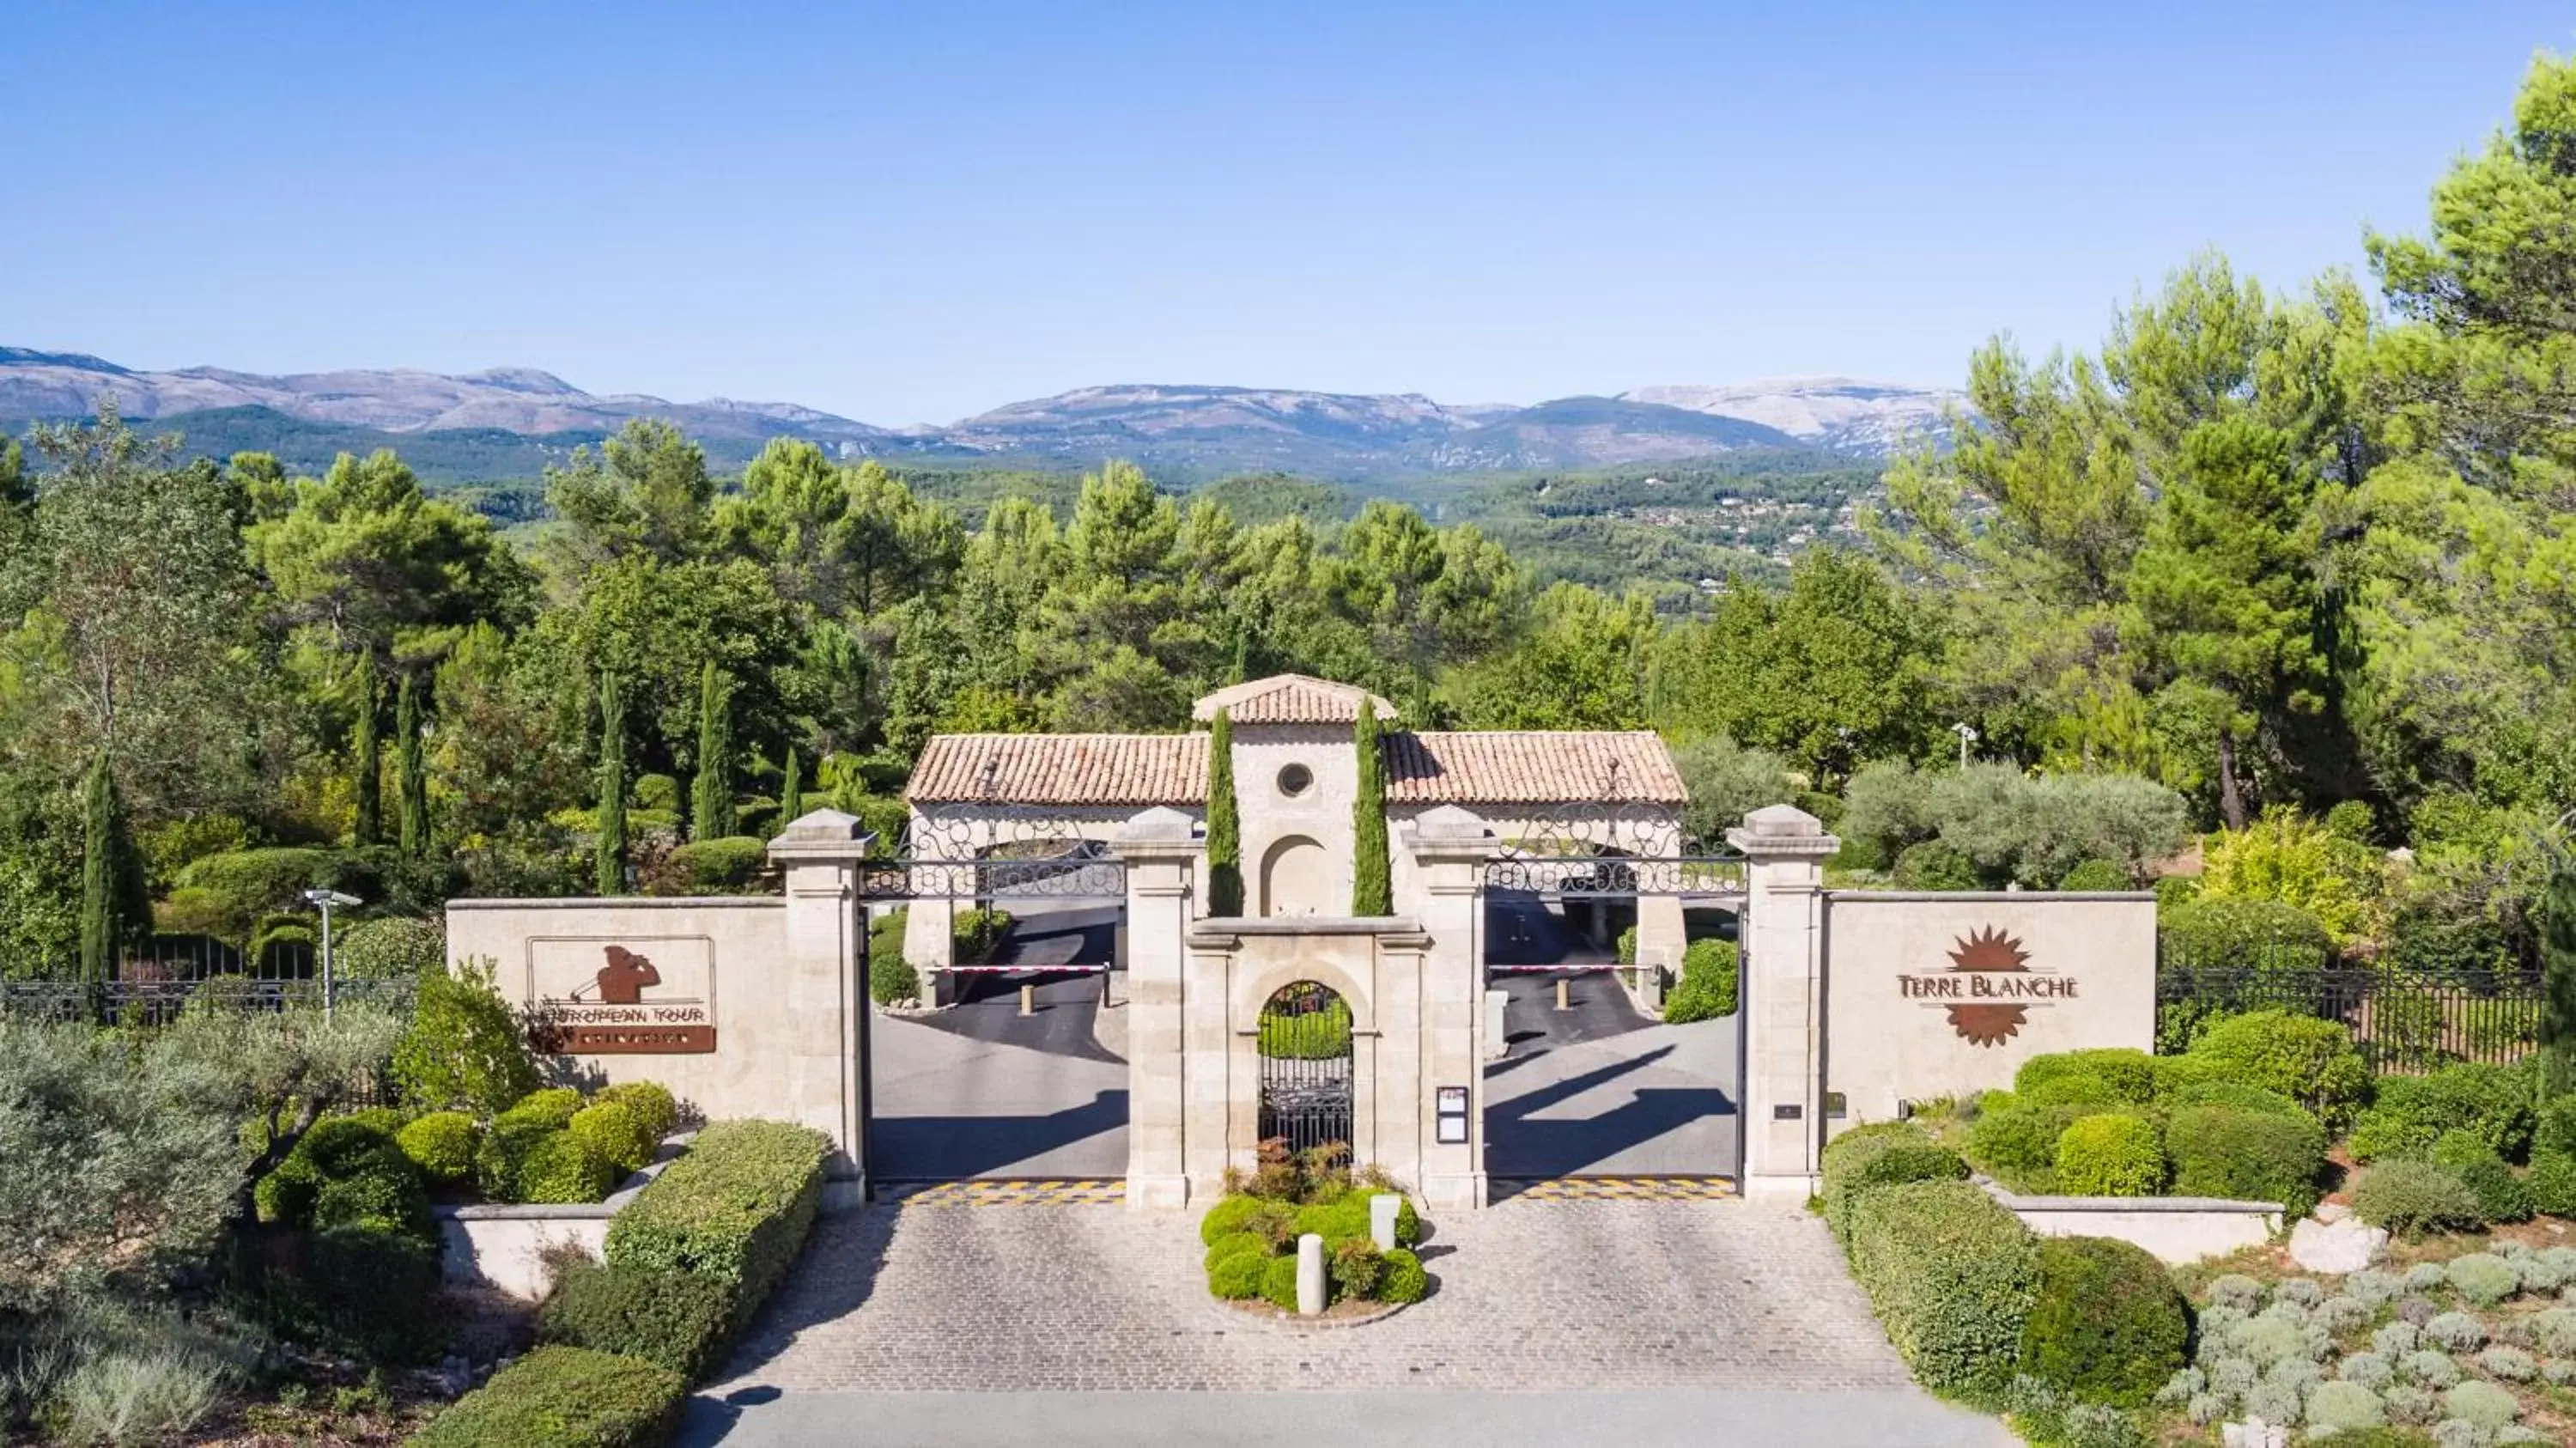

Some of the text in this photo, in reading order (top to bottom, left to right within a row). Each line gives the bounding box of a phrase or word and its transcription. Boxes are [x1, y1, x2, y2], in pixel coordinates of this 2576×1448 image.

[1897, 975, 2078, 998] TERRE BLANCHE
[651, 1008, 704, 1023] TOUR
